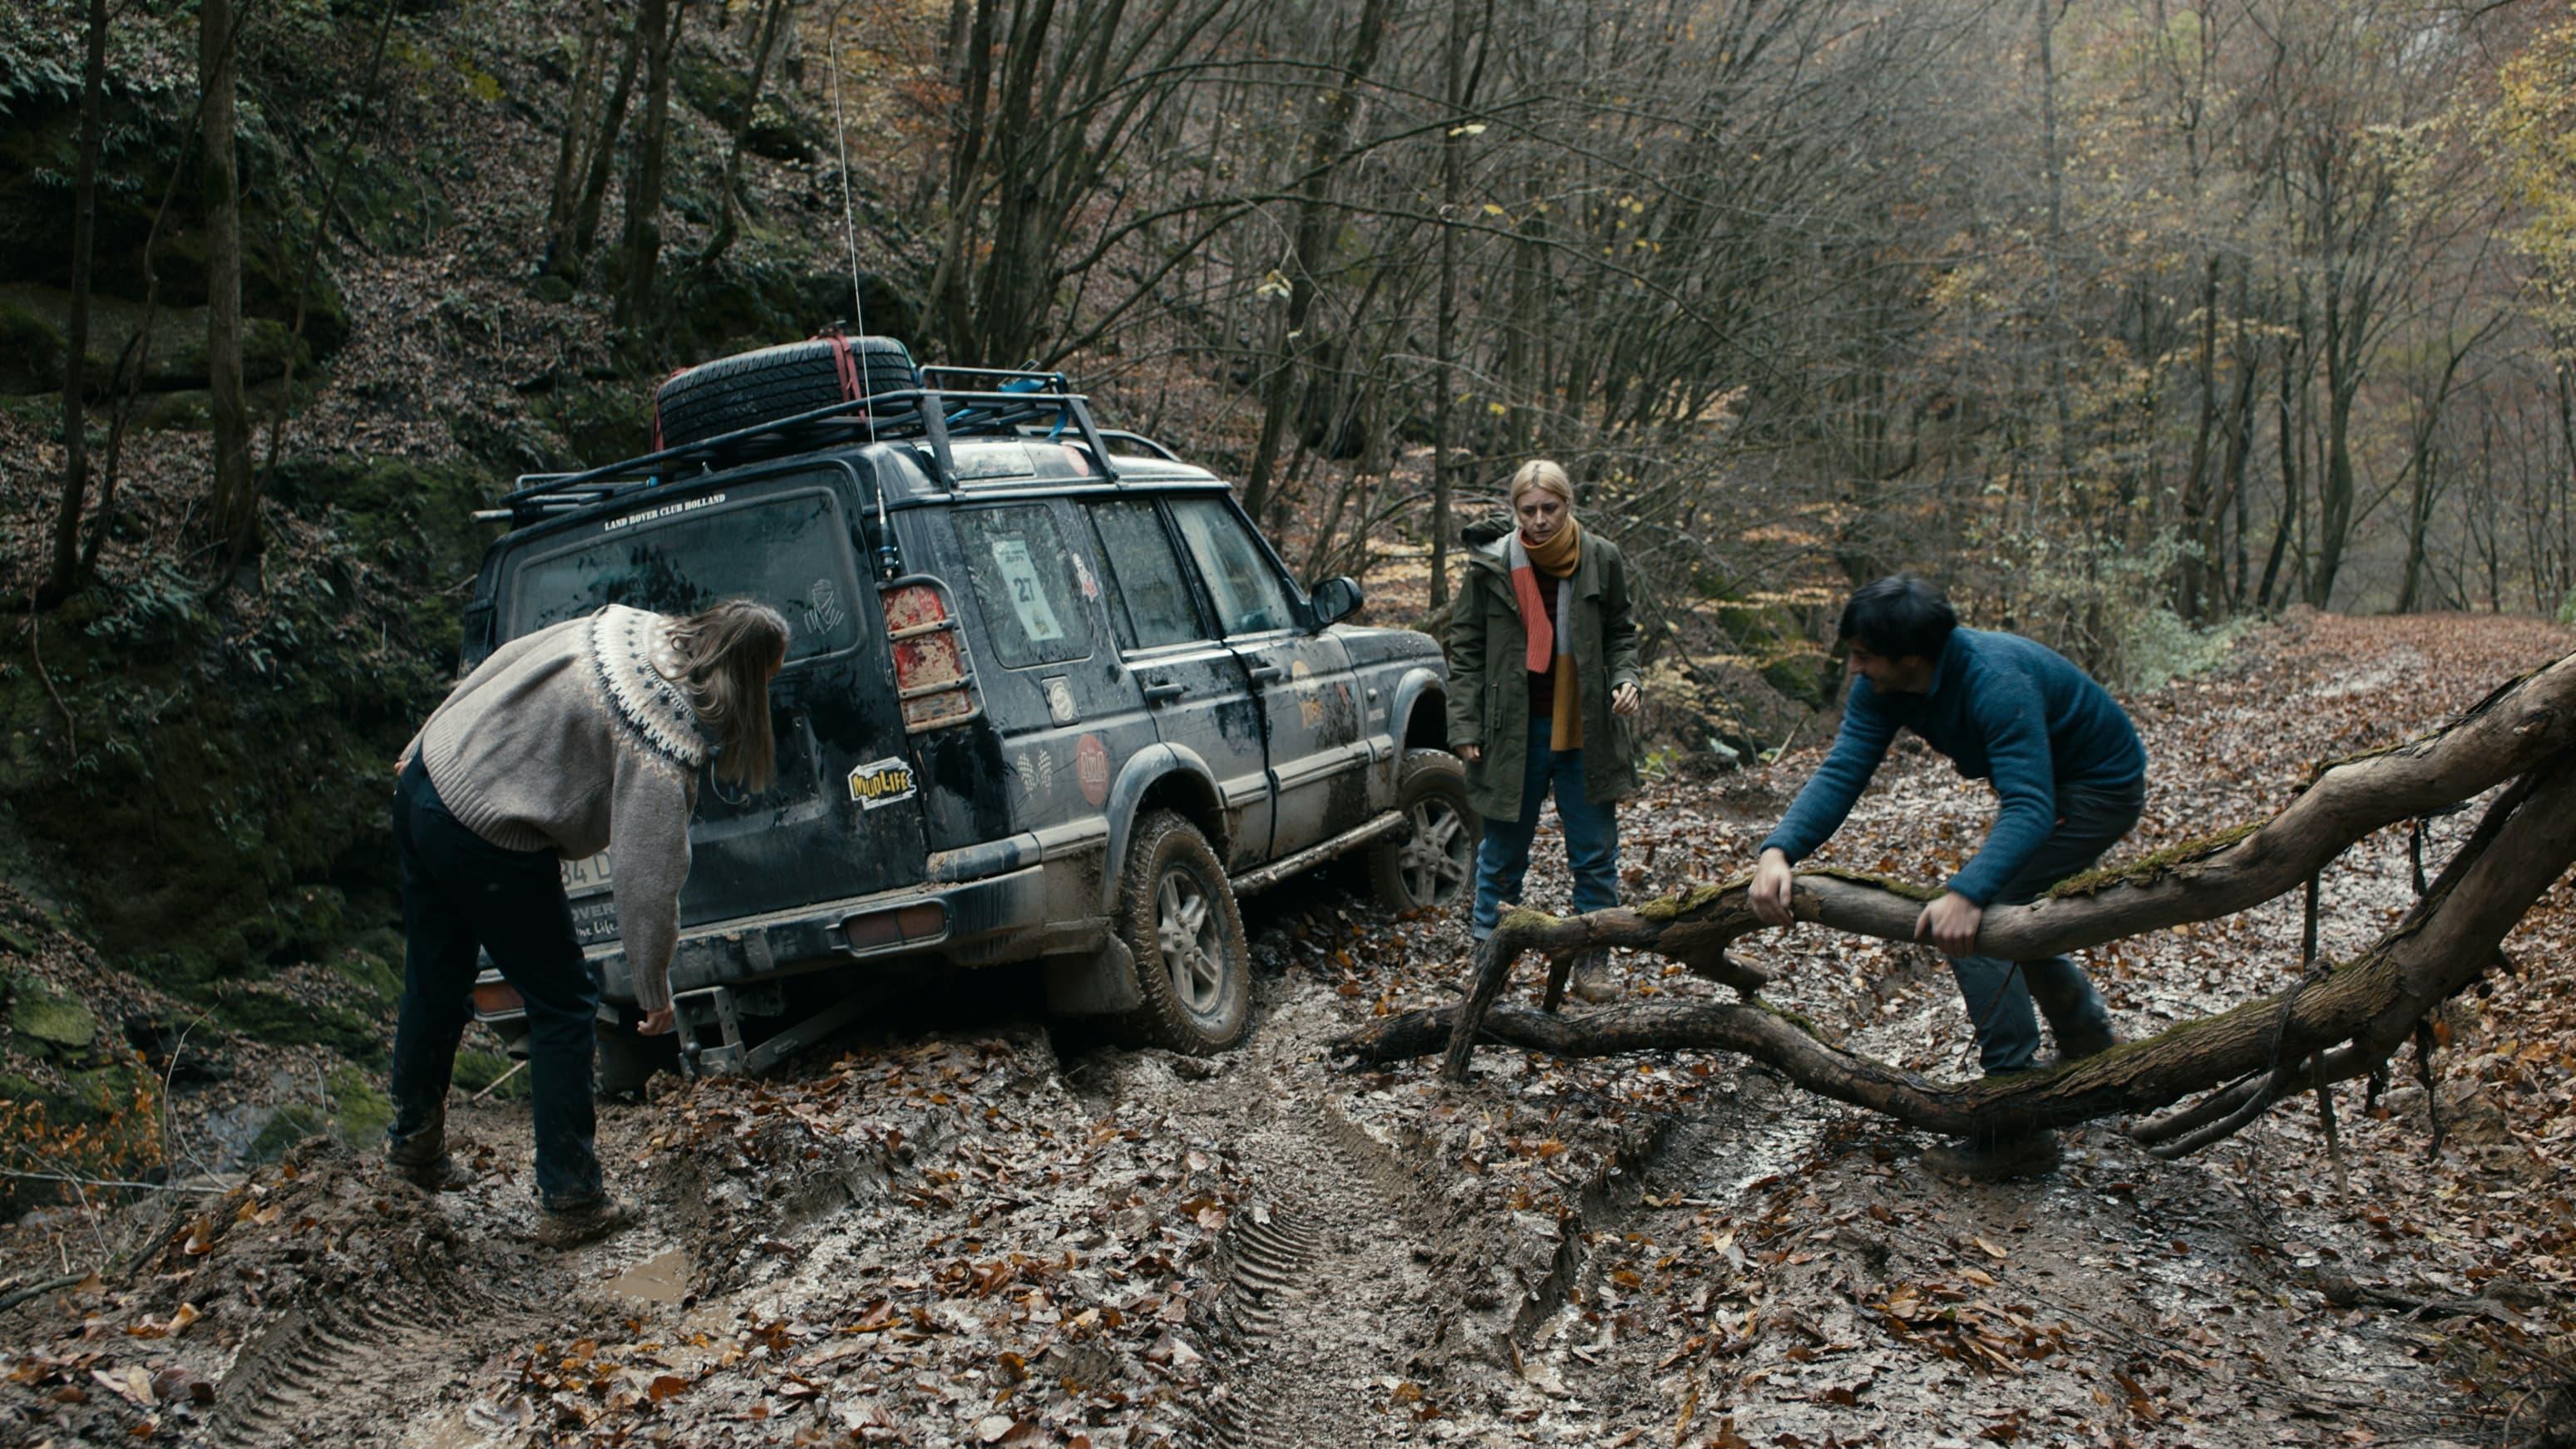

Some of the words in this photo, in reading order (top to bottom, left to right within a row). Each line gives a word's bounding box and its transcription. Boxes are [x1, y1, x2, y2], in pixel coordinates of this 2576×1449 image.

[605, 517, 628, 531] LAND
[629, 510, 658, 525] ROVER
[659, 504, 683, 516] CLUB
[684, 493, 726, 510] HOLLAND
[1013, 577, 1035, 603] 27
[571, 902, 616, 922] OVER
